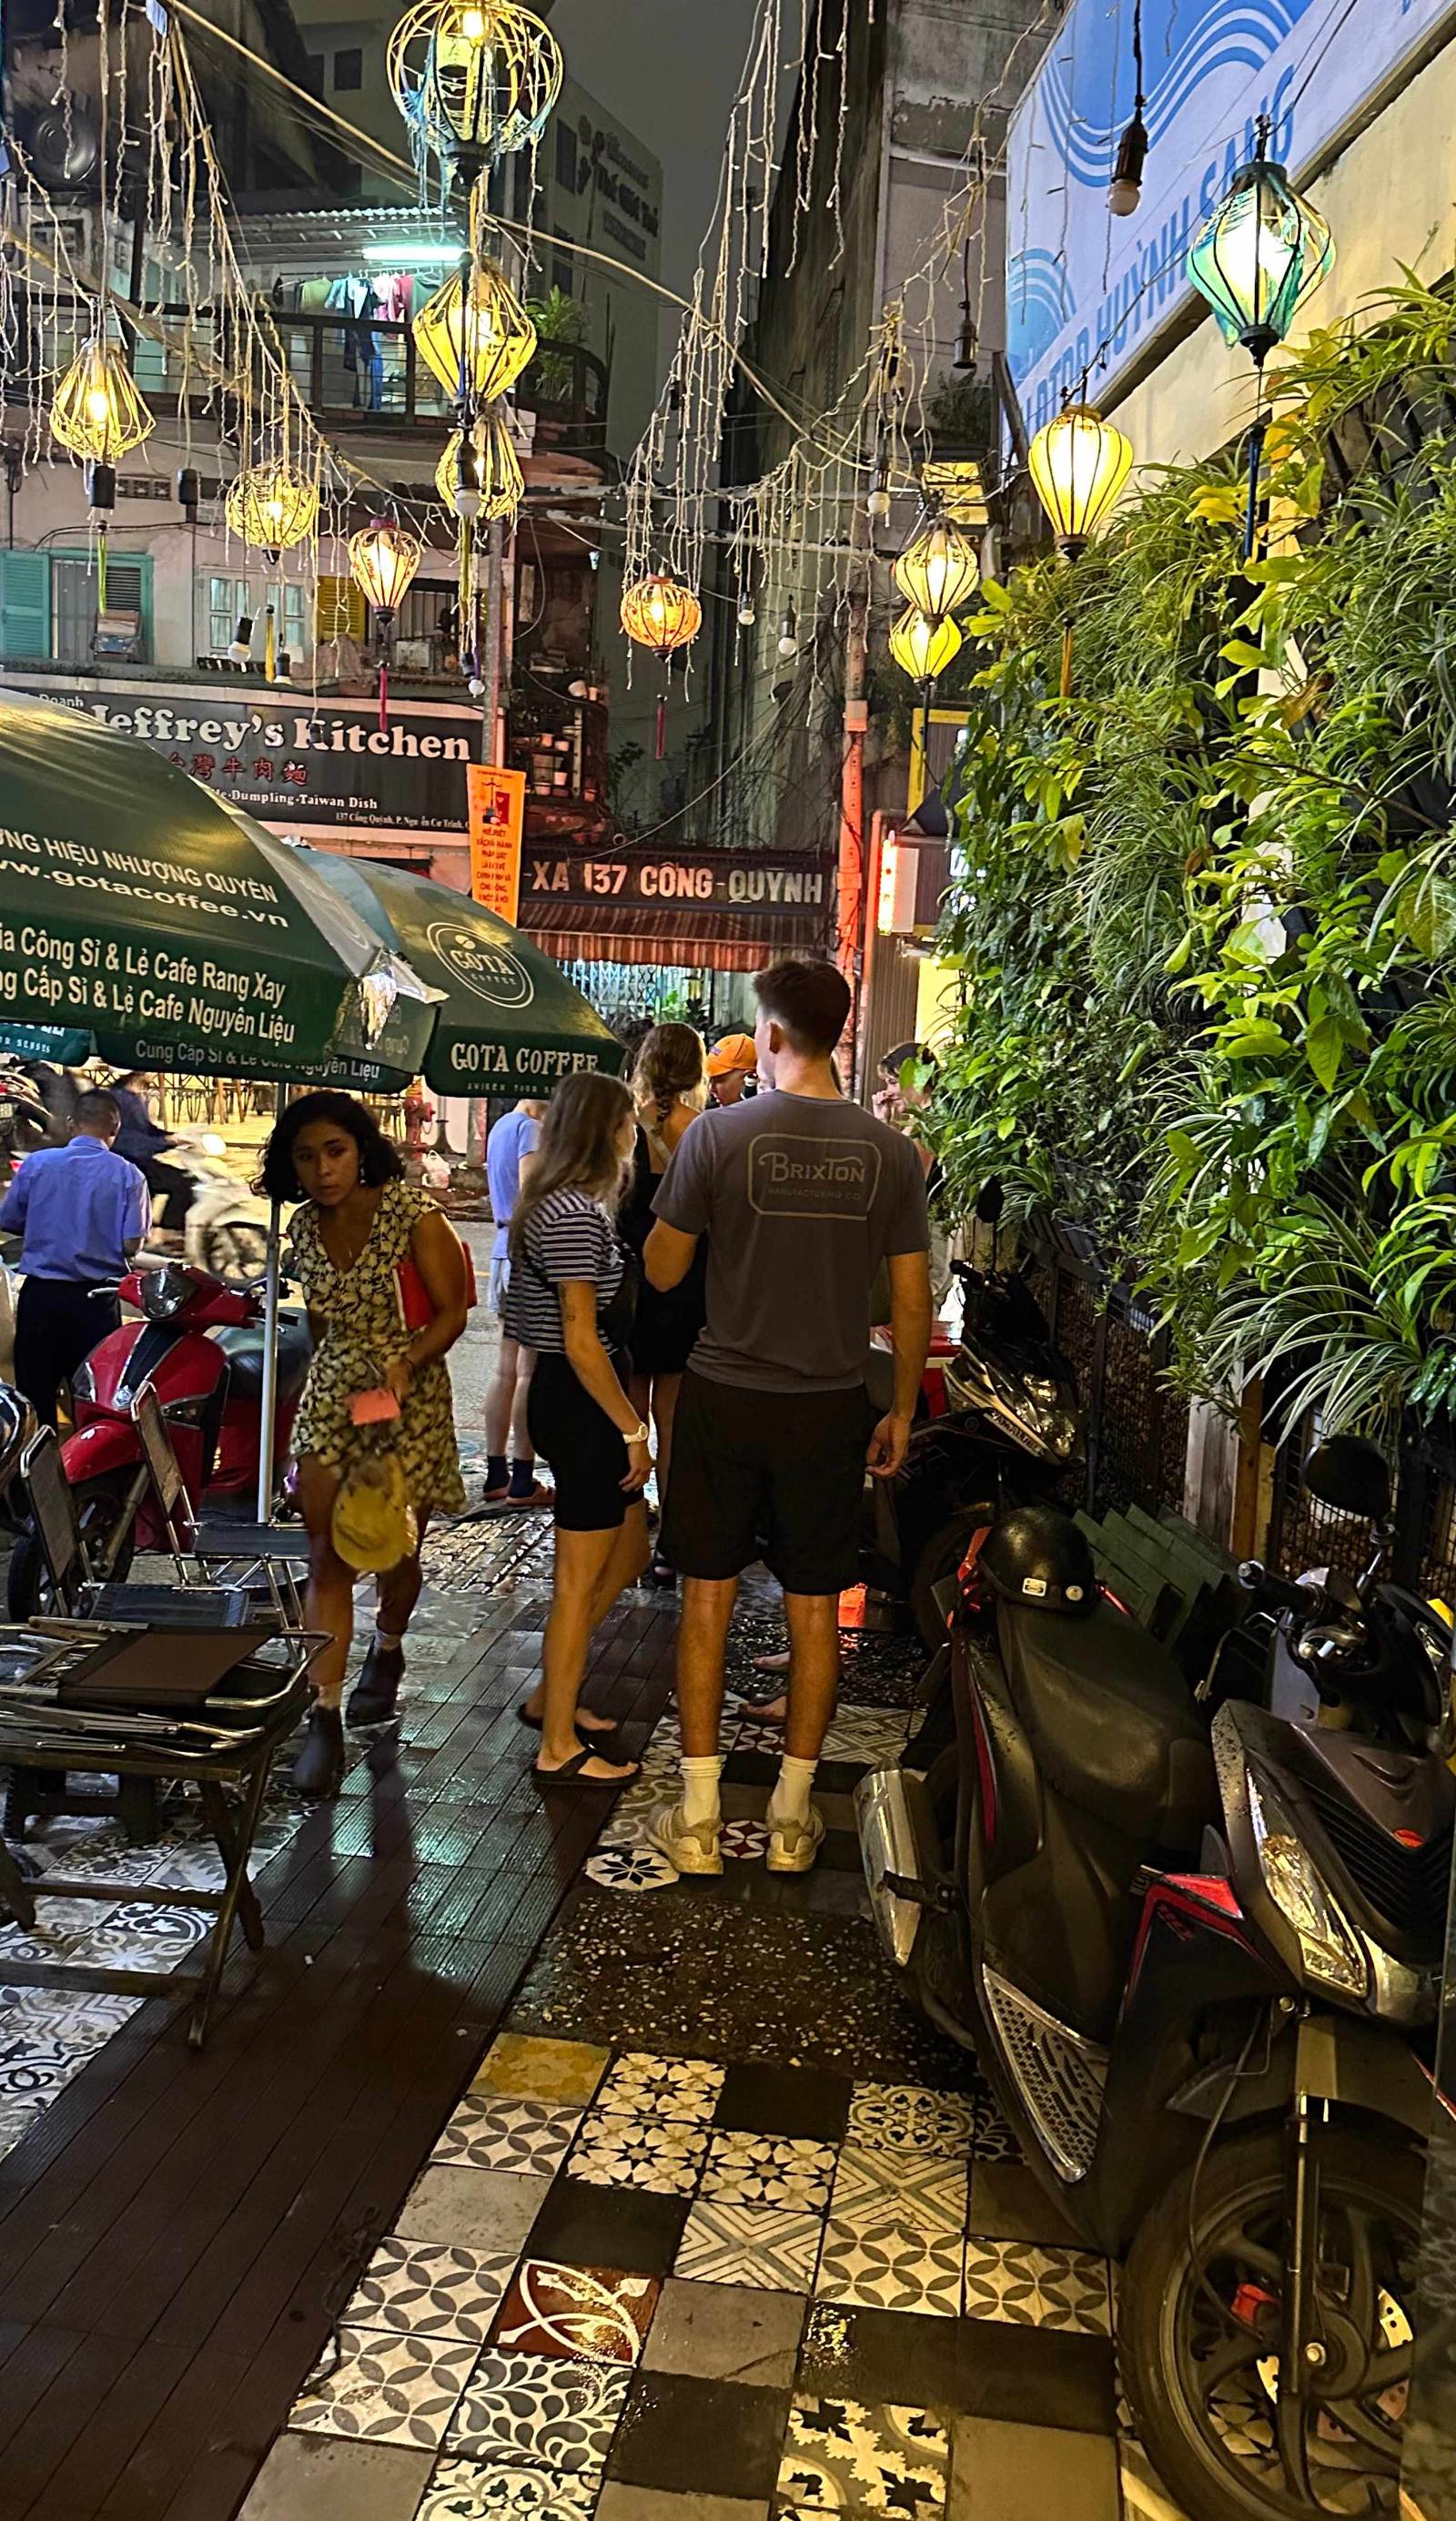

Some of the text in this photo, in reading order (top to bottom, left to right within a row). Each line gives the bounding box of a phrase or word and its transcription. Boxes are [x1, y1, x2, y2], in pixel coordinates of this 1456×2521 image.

[91, 704, 471, 761] Jeffrey's Kitchen
[349, 797, 378, 809] Dish
[44, 837, 100, 866] HIỆU
[102, 850, 203, 886] NHƯỢNG
[583, 864, 627, 895] 137
[20, 926, 75, 969] Công
[80, 937, 101, 967] Sỉ
[106, 943, 120, 971] &
[126, 946, 148, 977] Lẻ
[154, 953, 197, 986] Cafe
[202, 961, 249, 1001] Rang
[252, 971, 286, 1008] Xay
[450, 949, 515, 977] GOTA
[24, 965, 64, 1007] Cấp
[68, 976, 88, 1005] Sỉ
[93, 980, 108, 1008] &
[113, 985, 135, 1013] Lẻ
[139, 989, 183, 1021] Cafe
[188, 997, 255, 1038] Nguyên
[258, 1011, 296, 1047] Liệu
[136, 1039, 173, 1063] Cung
[450, 1042, 599, 1078] GOTA COFFEE
